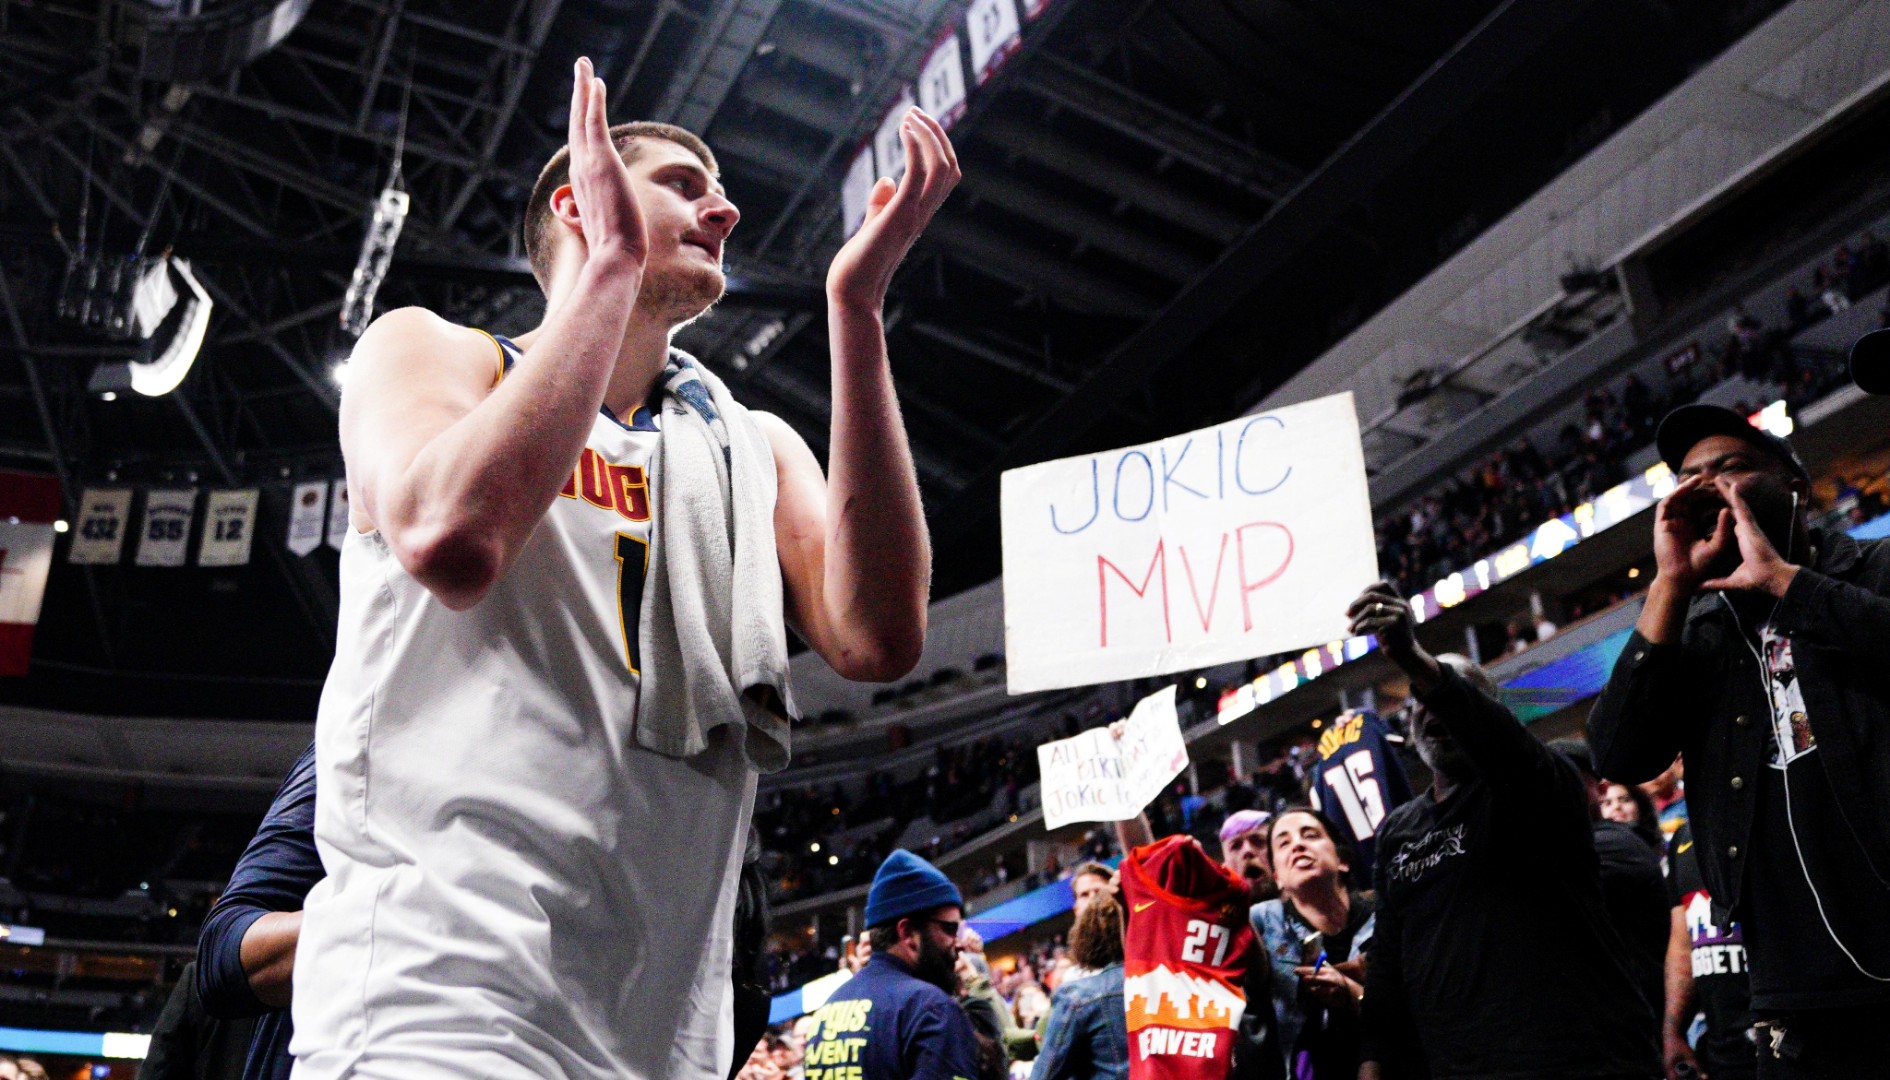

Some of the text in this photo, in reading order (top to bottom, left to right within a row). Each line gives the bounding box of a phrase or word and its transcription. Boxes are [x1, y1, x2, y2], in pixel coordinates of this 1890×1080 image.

[1050, 416, 1292, 534] JOKIC
[148, 518, 184, 541] 55
[215, 519, 244, 541] 12
[1098, 521, 1294, 647] MVP
[1324, 750, 1386, 841] 15
[1181, 918, 1231, 967] 27
